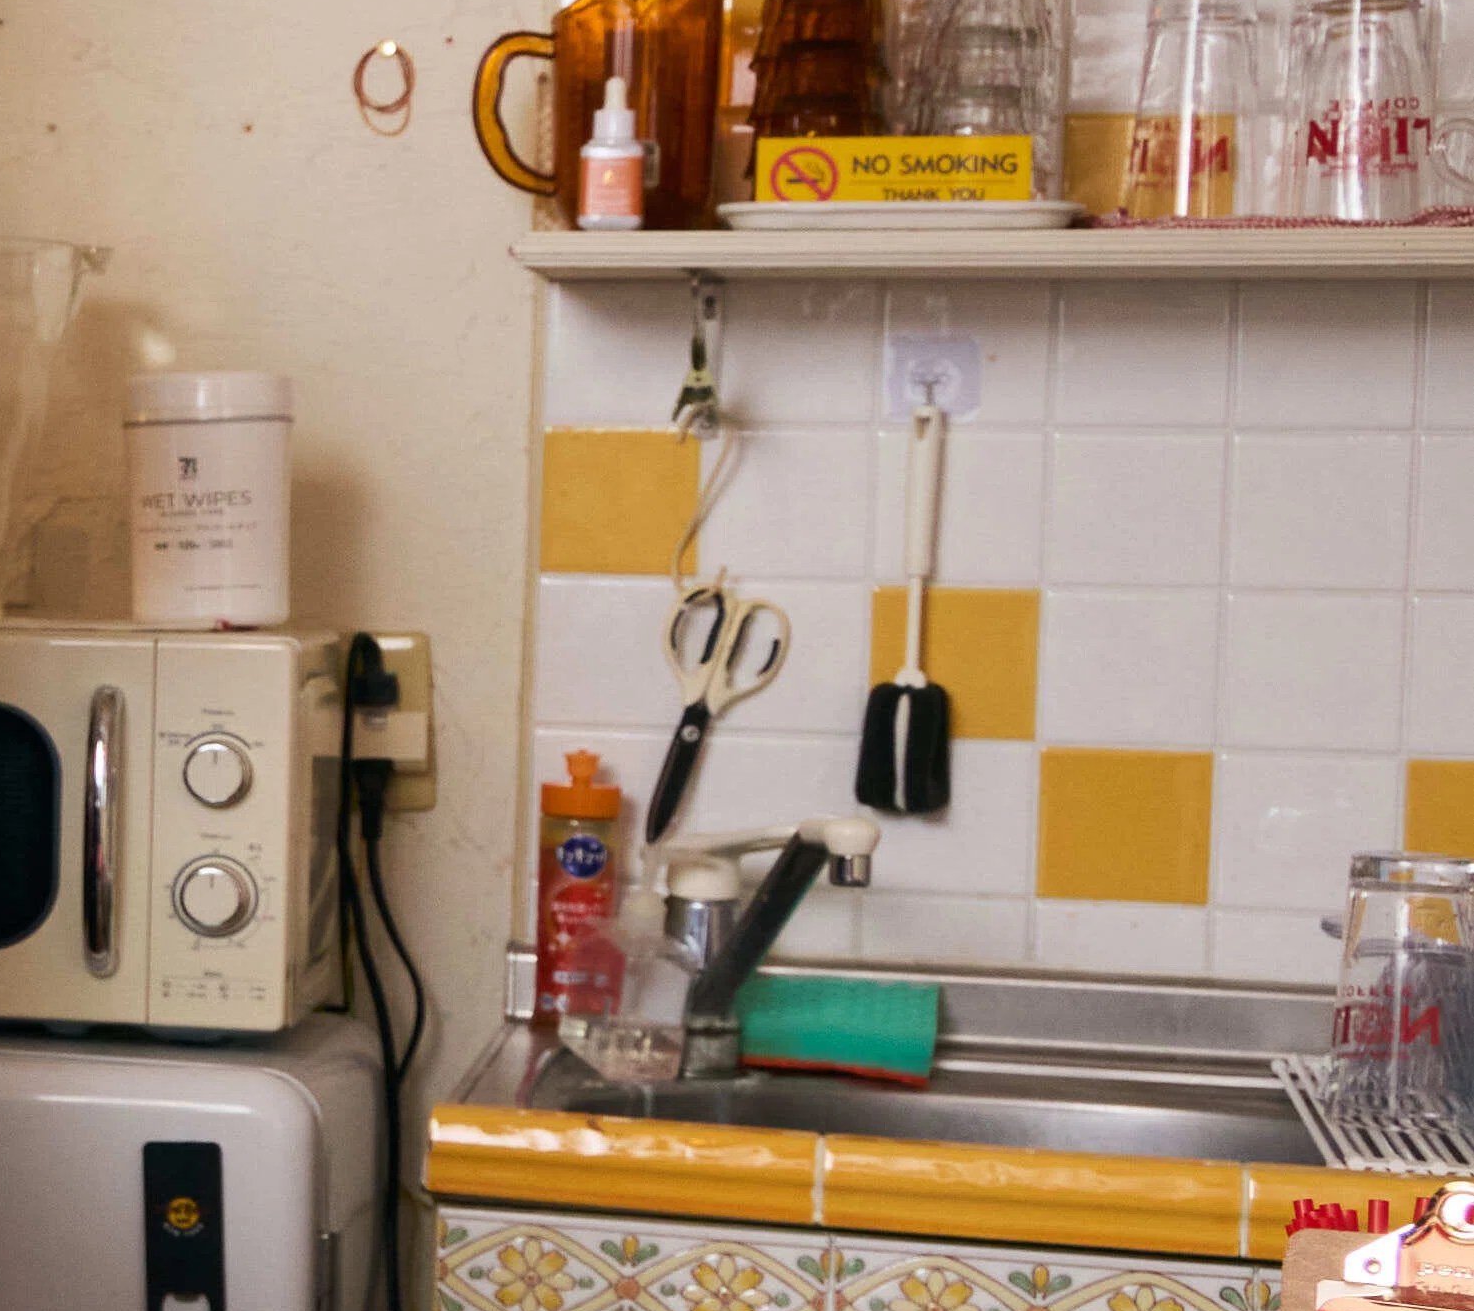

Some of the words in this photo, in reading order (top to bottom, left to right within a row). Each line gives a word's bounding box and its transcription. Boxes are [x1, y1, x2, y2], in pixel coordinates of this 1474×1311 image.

[851, 153, 891, 176] NO
[899, 152, 1019, 176] SMOKING
[882, 187, 940, 201] THANK
[948, 187, 986, 201] YOU
[141, 492, 176, 509] WET
[183, 490, 253, 508] WIPES
[1416, 1260, 1474, 1285] pen
